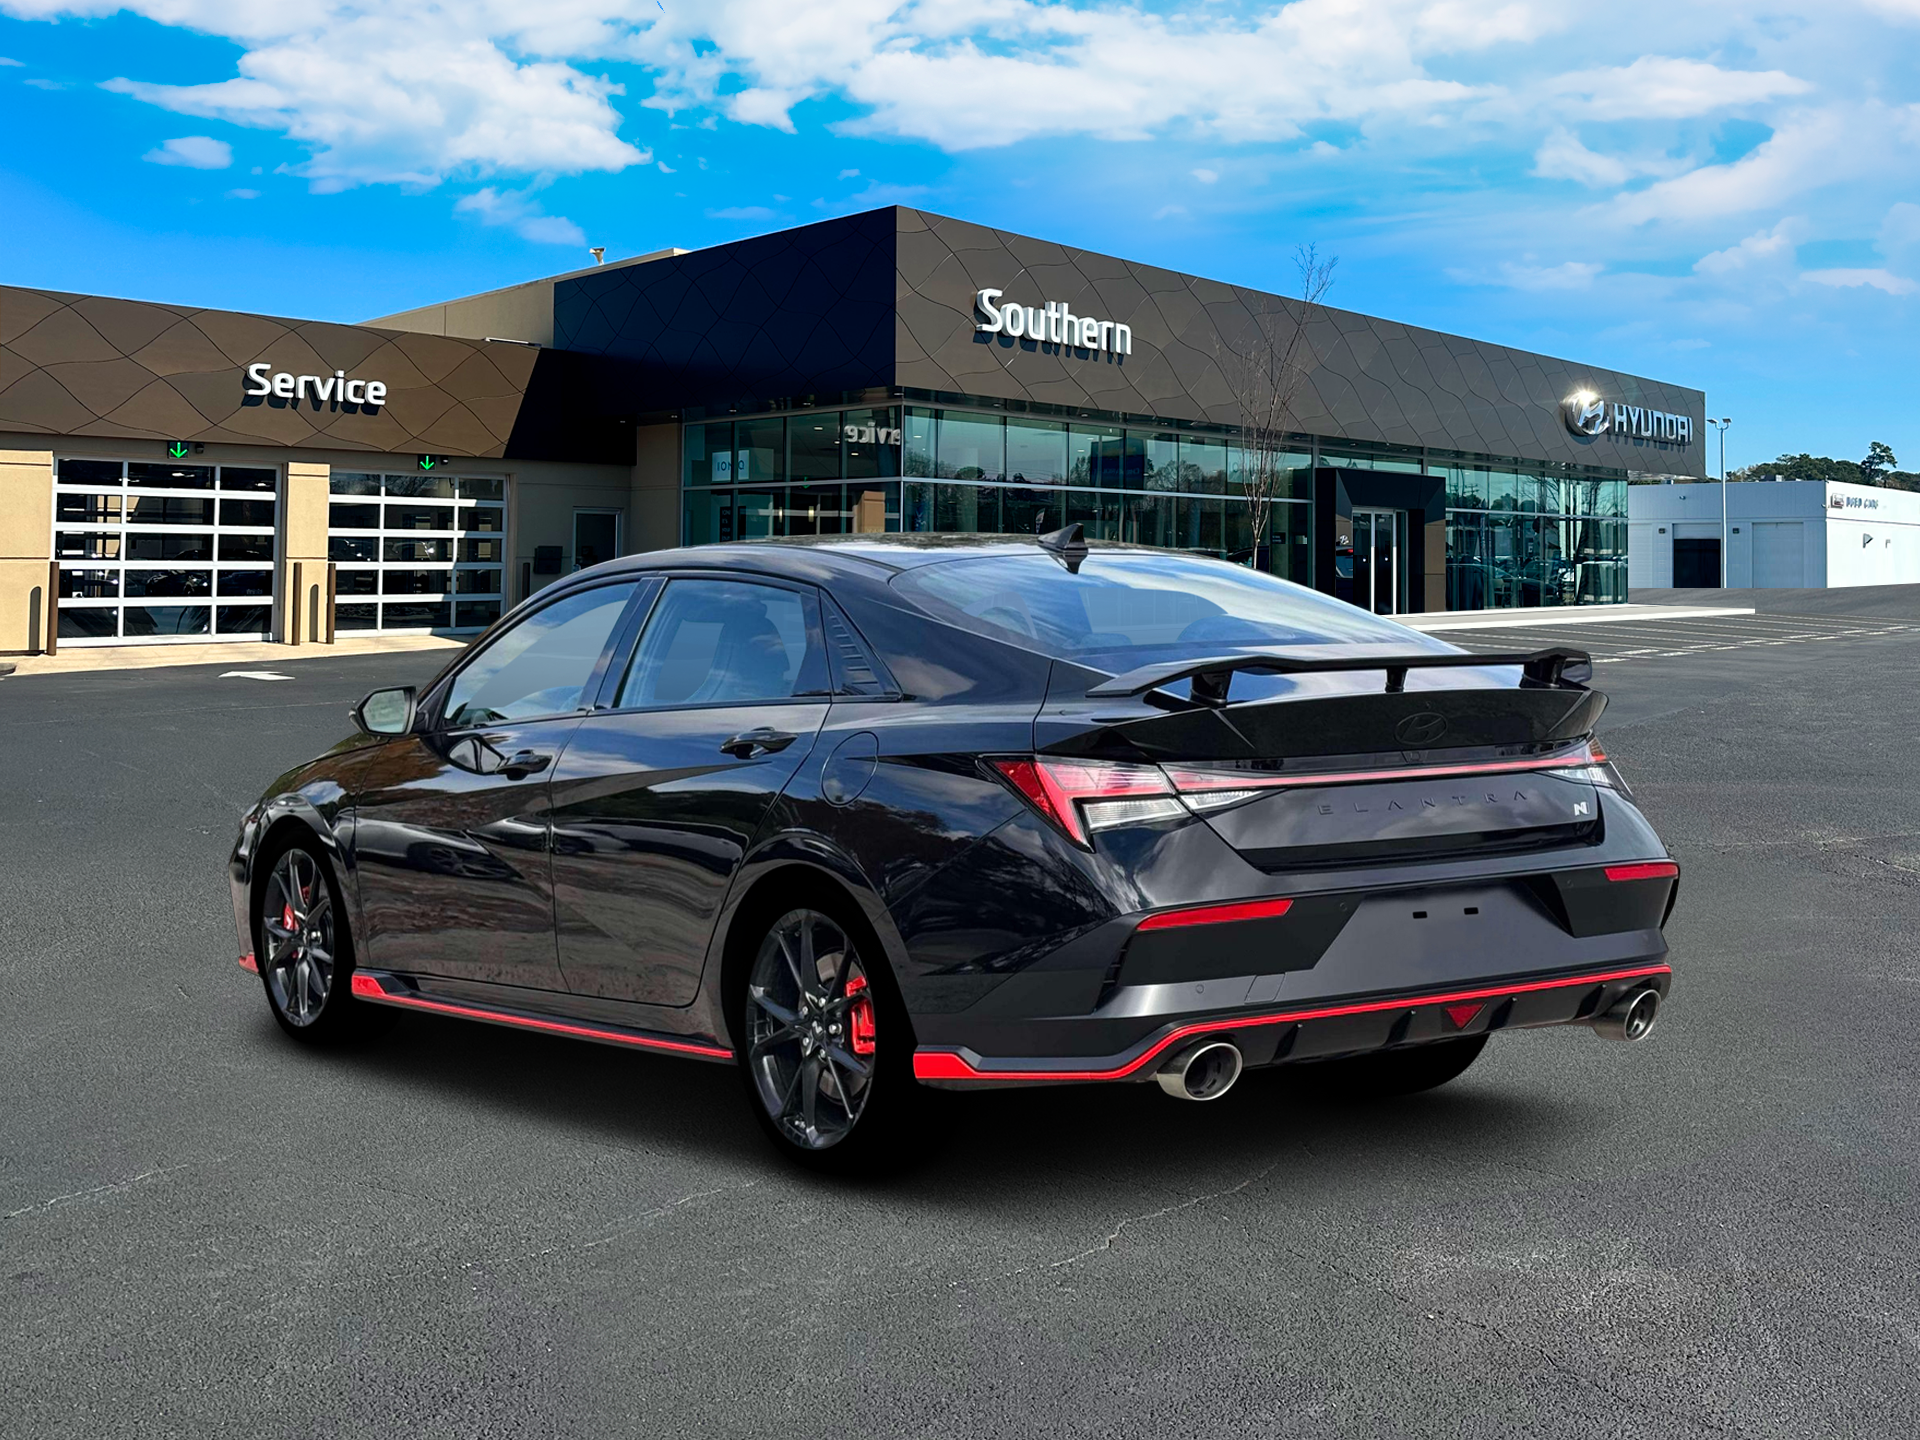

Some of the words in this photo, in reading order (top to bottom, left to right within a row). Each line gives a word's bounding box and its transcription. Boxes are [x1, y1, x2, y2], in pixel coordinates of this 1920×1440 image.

[976, 288, 1132, 355] Southern
[246, 362, 387, 406] Service
[1613, 402, 1693, 443] HYUNDAI
[1318, 790, 1528, 816] ELANTRA
[1573, 801, 1590, 816] N
